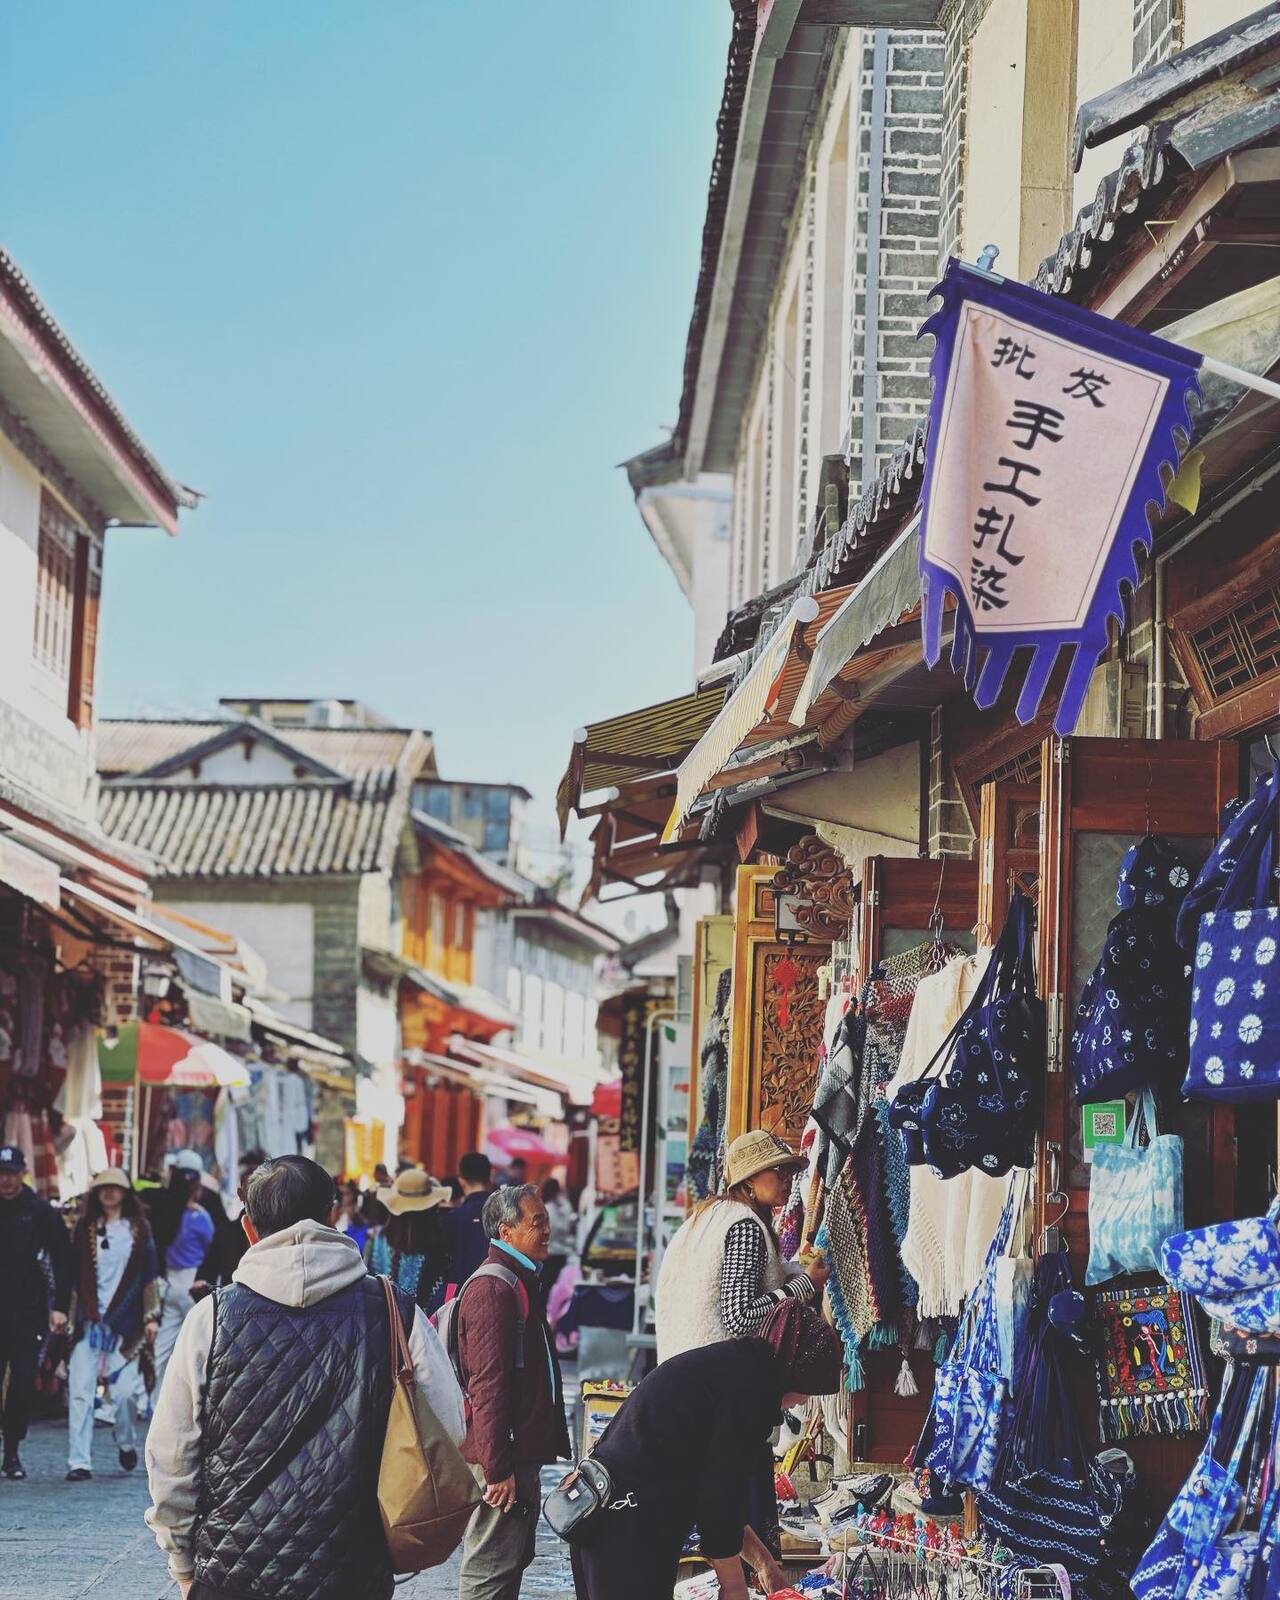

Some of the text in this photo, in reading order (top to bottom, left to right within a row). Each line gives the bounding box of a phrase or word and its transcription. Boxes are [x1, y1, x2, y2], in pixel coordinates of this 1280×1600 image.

[990, 337, 1111, 408] 批发
[970, 399, 1065, 611] 手工扎染
